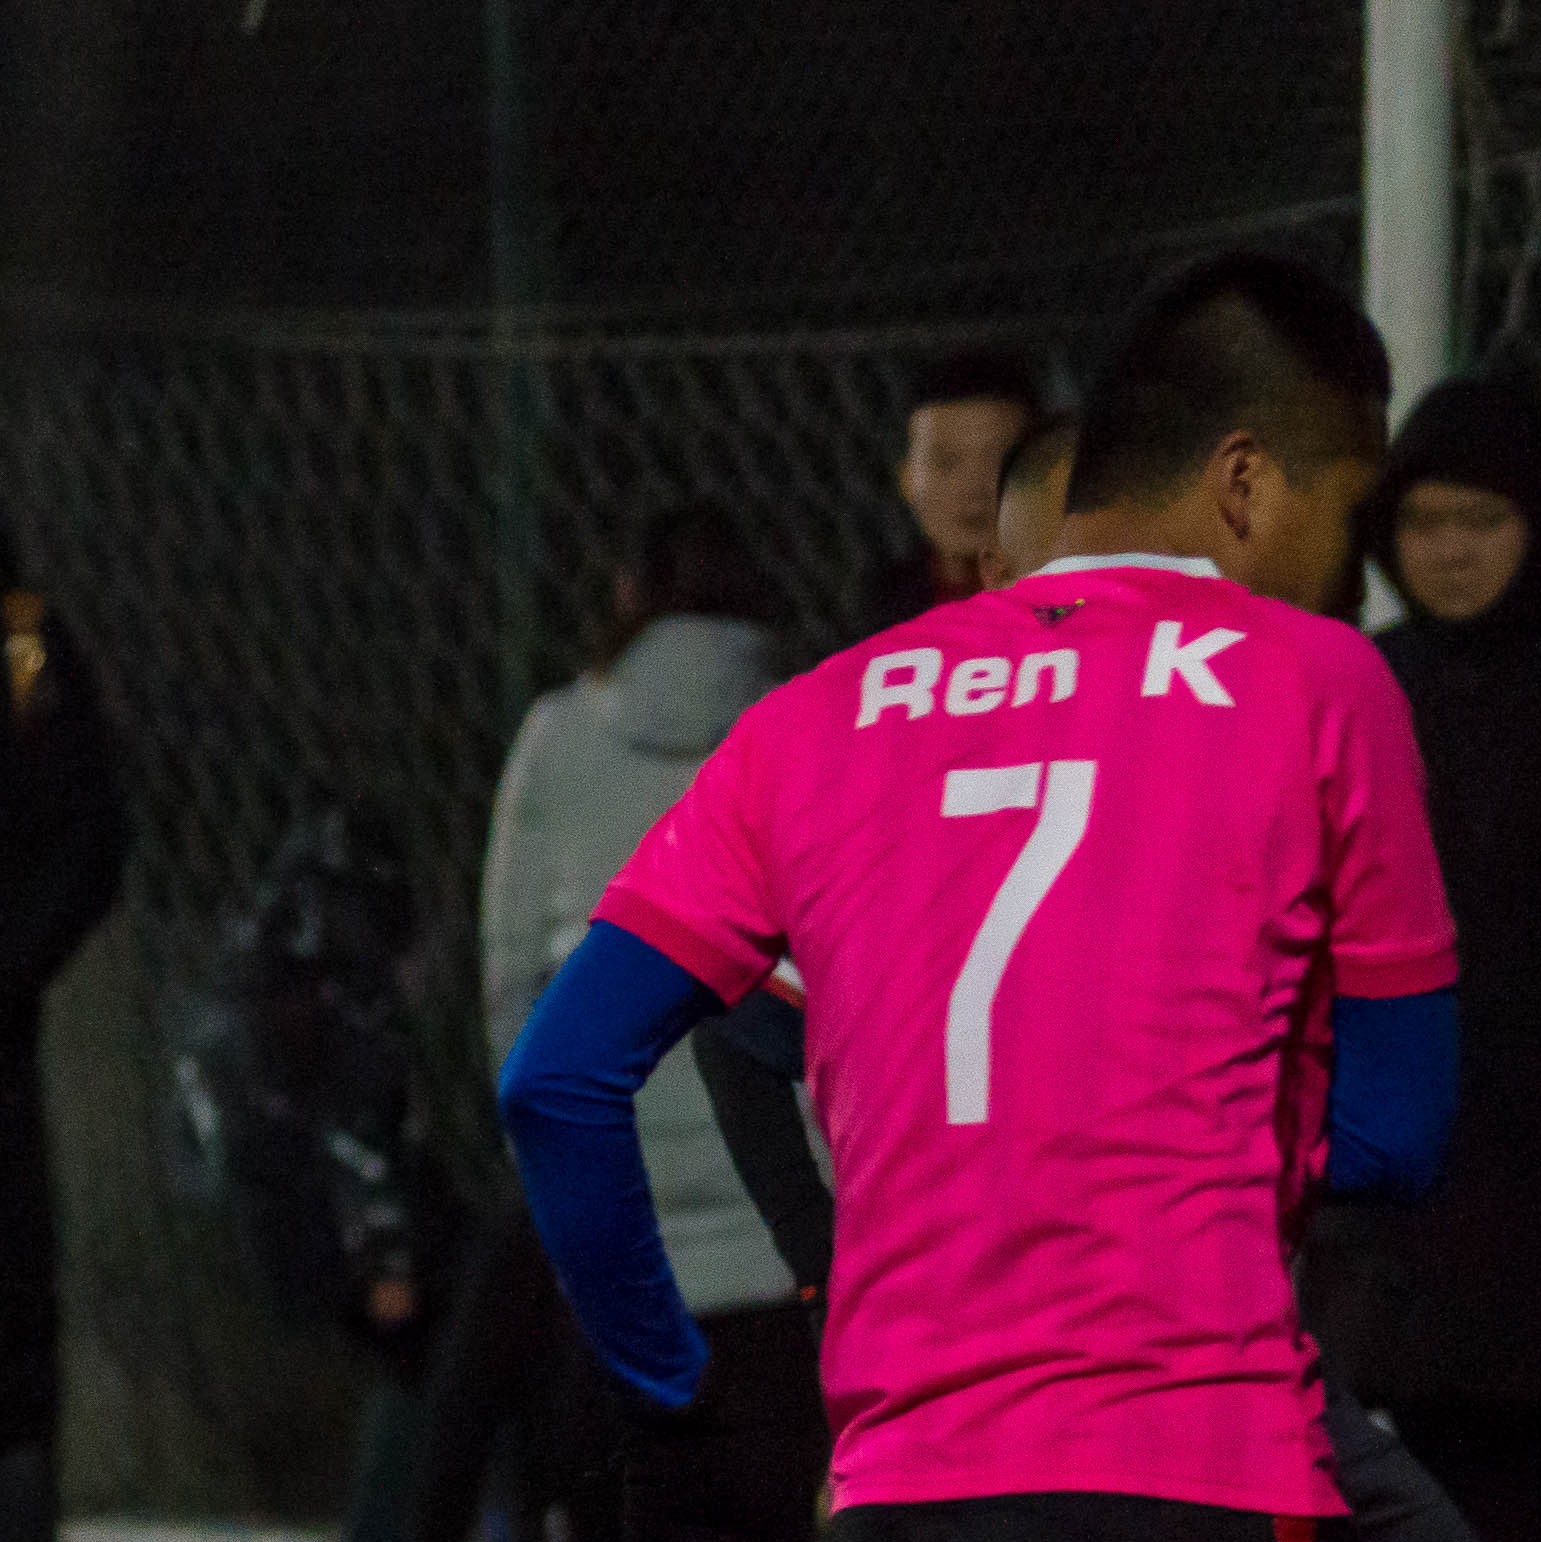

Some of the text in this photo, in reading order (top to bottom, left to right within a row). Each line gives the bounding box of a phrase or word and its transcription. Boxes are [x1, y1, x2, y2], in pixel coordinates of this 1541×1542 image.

[854, 619, 1249, 730] Ren K
[940, 758, 1098, 1127] 7
